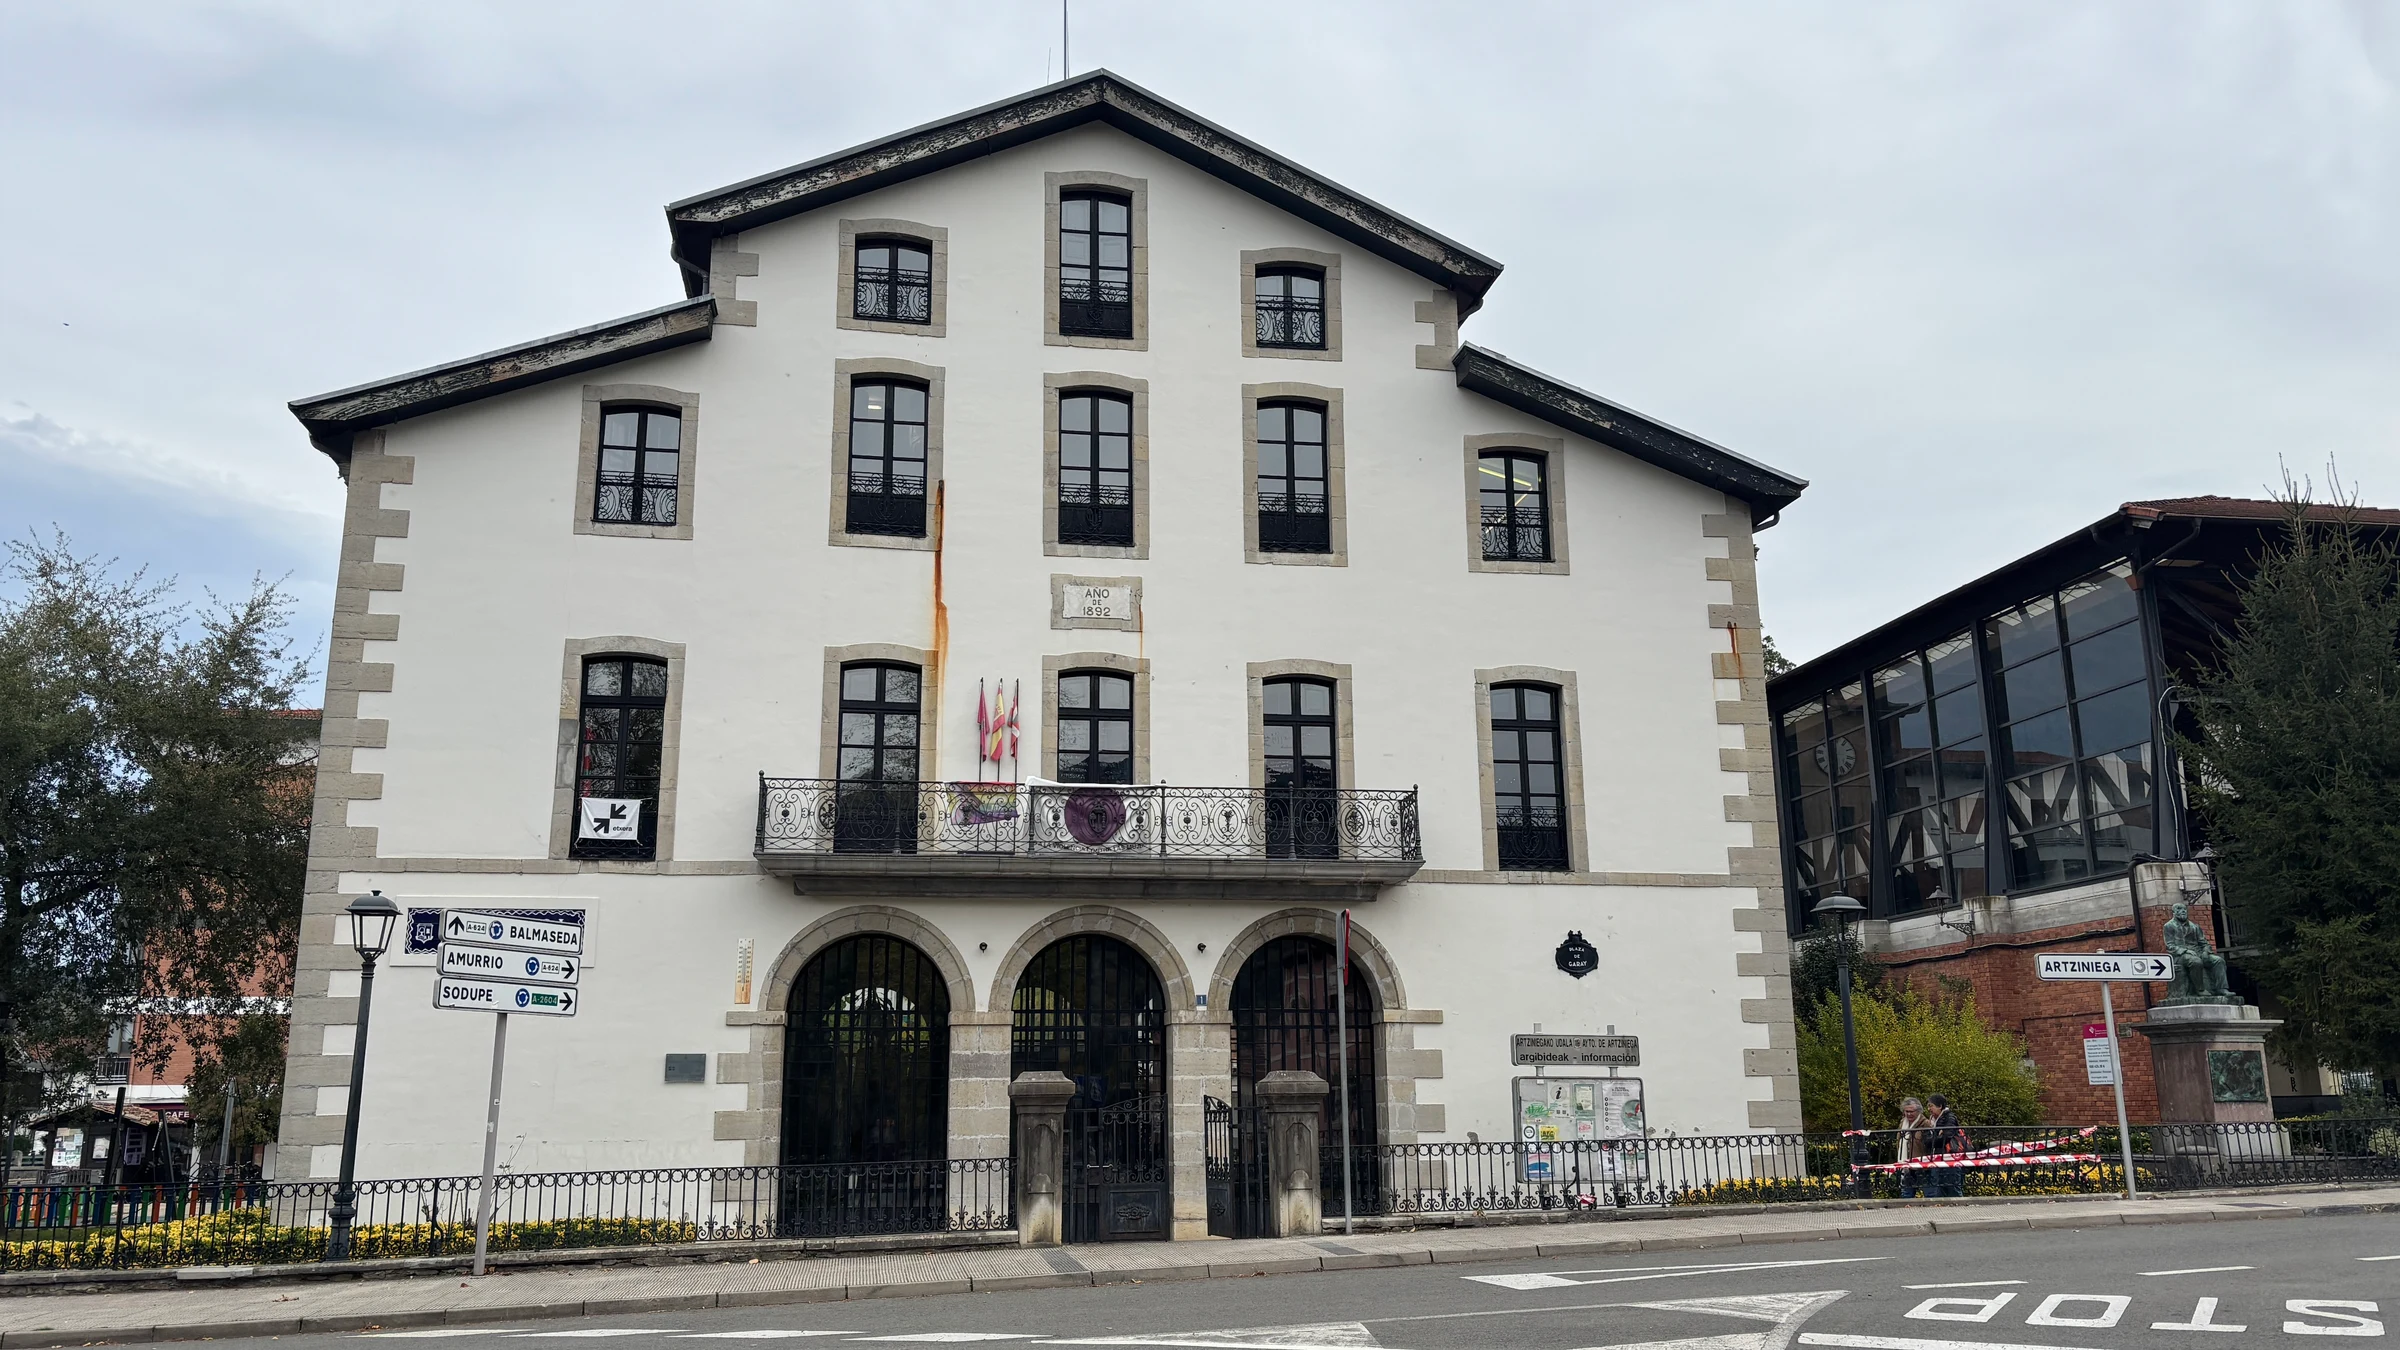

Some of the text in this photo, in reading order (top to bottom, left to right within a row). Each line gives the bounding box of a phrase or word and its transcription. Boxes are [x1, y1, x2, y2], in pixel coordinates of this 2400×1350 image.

[1085, 586, 1110, 599] AÑO
[1082, 606, 1111, 617] 1892
[467, 924, 578, 946] A-624 BALMASEDA
[447, 951, 504, 970] AMURRIO
[2045, 960, 2121, 973] ARTZINIEGA
[443, 985, 493, 1002] SODUPE
[1555, 1038, 1573, 1048] UDALA
[1598, 1039, 1606, 1048] DE
[1607, 1039, 1638, 1048] ARTZINIEGA
[1520, 1052, 1569, 1063] argibideak
[1581, 1053, 1637, 1062] información
[1903, 1293, 2386, 1336] STOP
